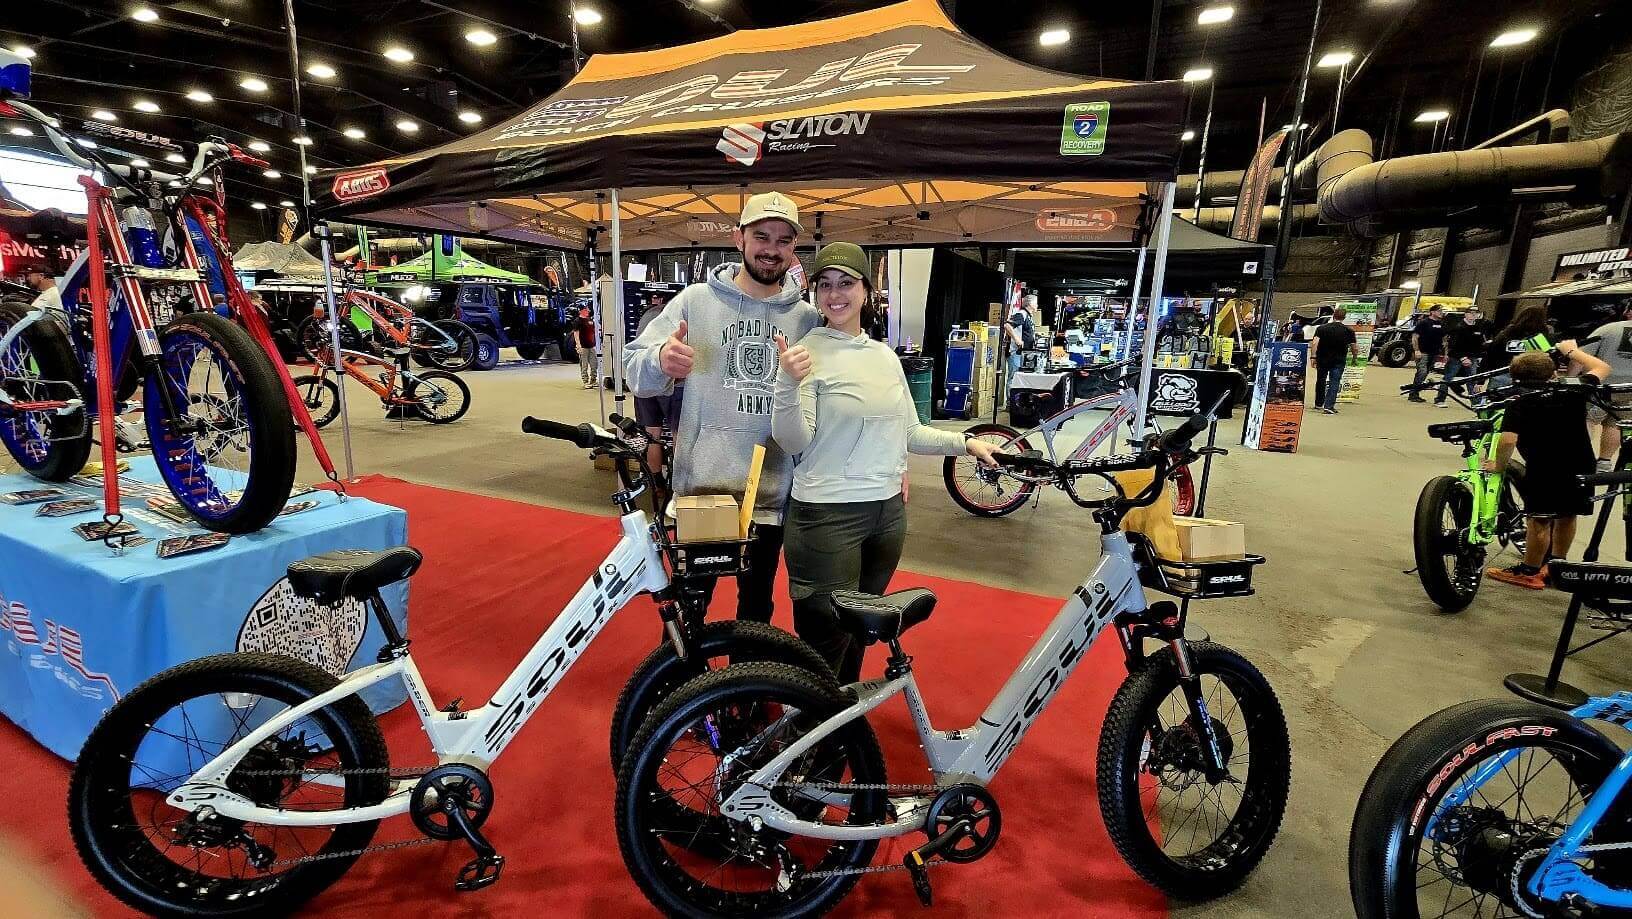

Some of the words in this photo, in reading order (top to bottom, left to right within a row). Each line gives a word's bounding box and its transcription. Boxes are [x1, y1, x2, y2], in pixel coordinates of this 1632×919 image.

[767, 113, 872, 140] SLATON
[1079, 121, 1091, 135] 2
[1063, 141, 1101, 149] RECOVERY
[340, 174, 383, 196] ABUS
[1560, 248, 1629, 267] UNLIMITED
[737, 319, 761, 338] BAD
[737, 393, 772, 414] ARMY
[484, 557, 646, 754] SOUL
[984, 577, 1133, 775] SOUL
[1427, 742, 1486, 798] SOUL
[1486, 725, 1558, 747] FAST
